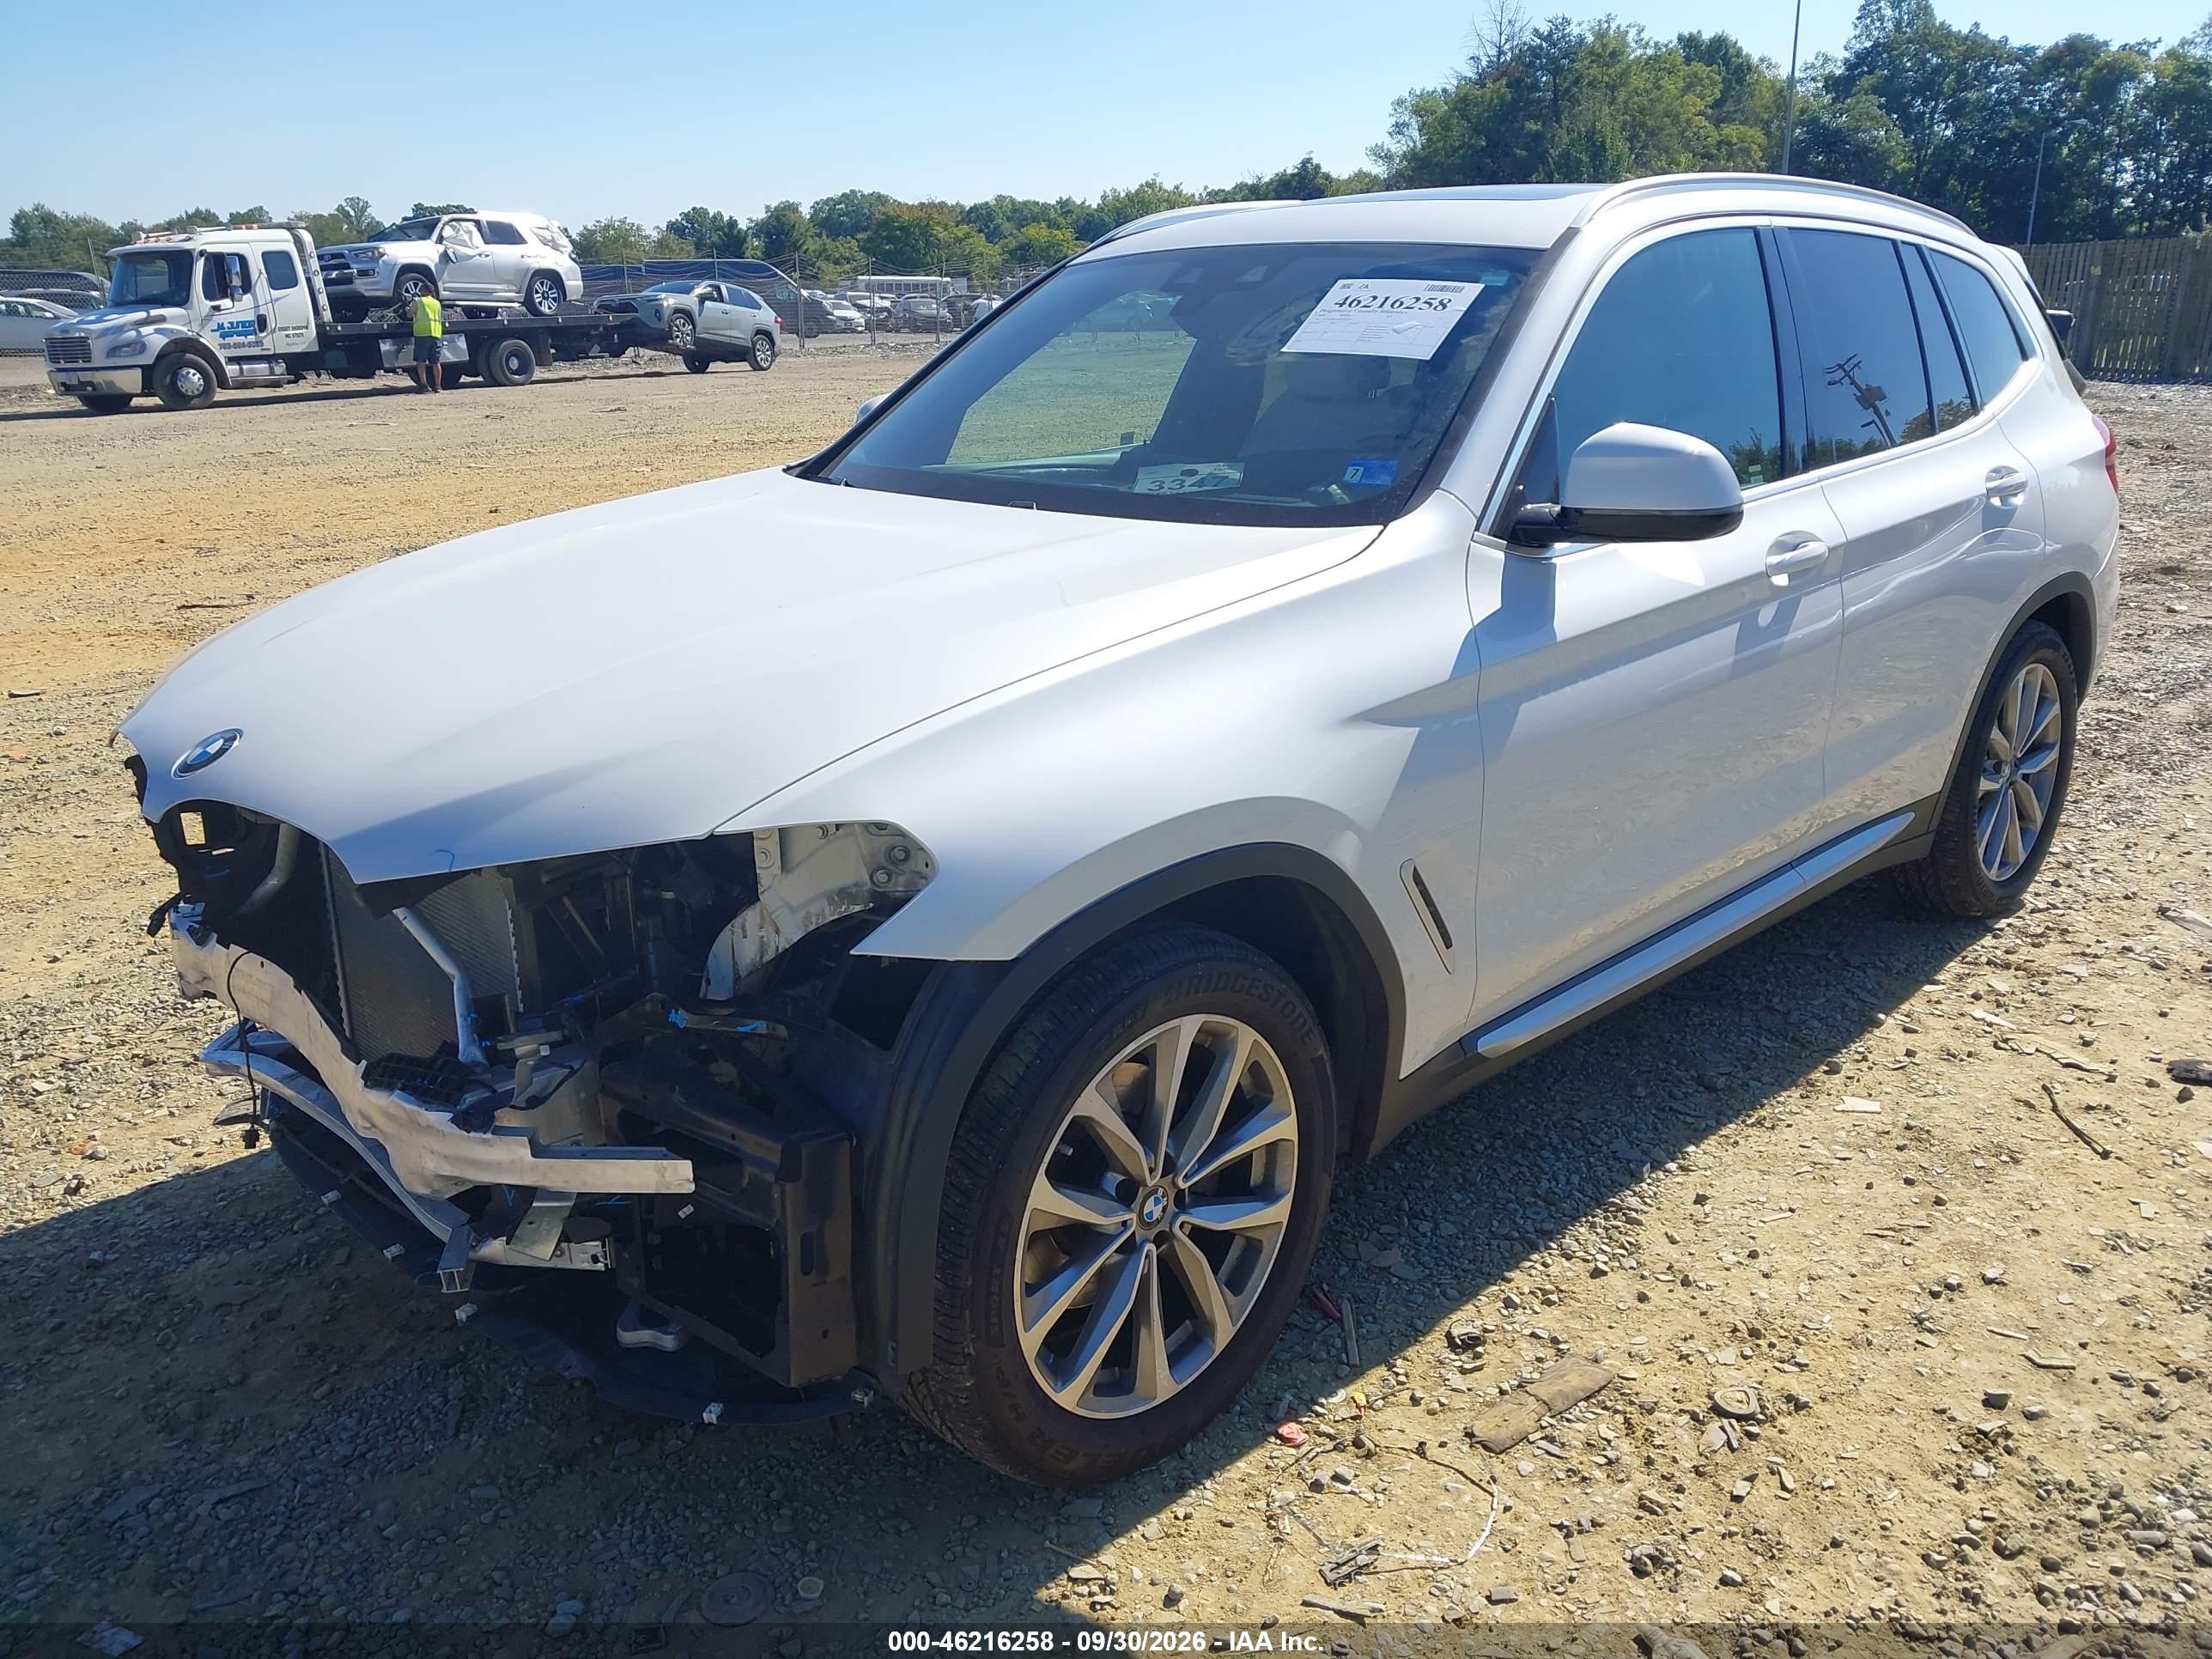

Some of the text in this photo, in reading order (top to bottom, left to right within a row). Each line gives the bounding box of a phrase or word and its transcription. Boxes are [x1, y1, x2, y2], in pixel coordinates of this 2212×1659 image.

[1334, 295, 1453, 312] 46216258
[1350, 468, 1360, 479] 7
[1166, 971, 1316, 1046] BRIDGESTONE
